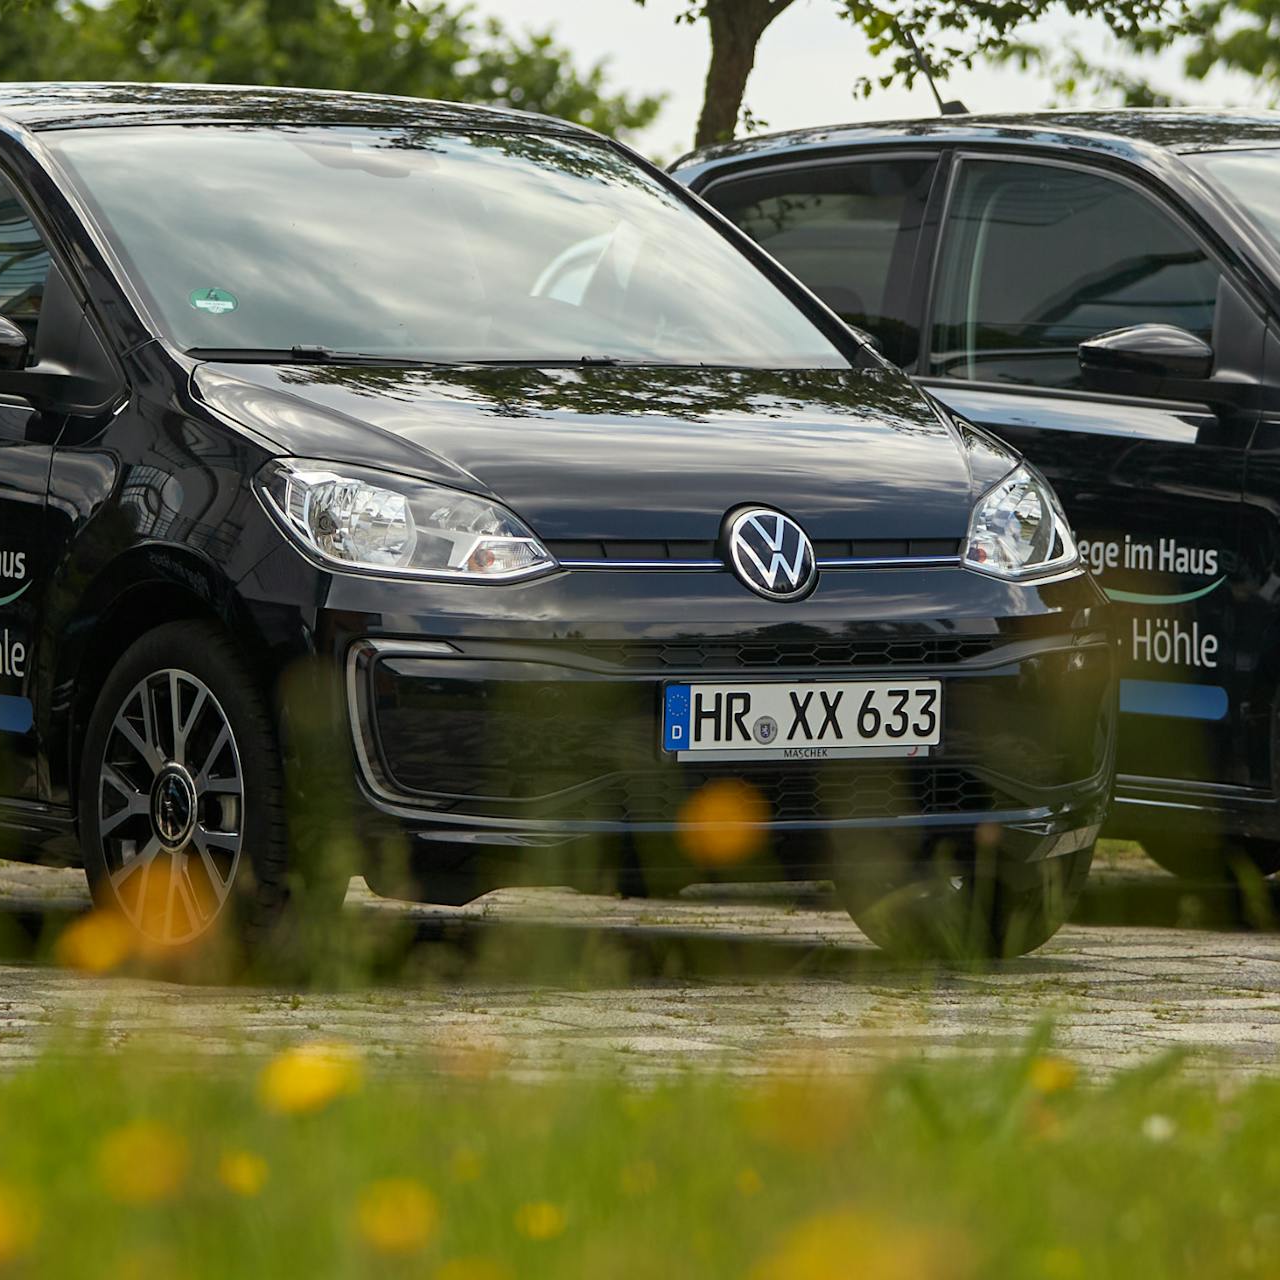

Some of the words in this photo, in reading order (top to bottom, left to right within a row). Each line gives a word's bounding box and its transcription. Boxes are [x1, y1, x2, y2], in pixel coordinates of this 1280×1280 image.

[732, 512, 809, 588] VW
[1124, 534, 1152, 571] im
[1159, 538, 1218, 576] Haus
[1133, 617, 1218, 668] Höhle
[672, 725, 682, 739] D
[694, 692, 752, 742] HR
[787, 691, 844, 741] XX
[857, 689, 937, 738] 633
[783, 747, 828, 758] MASCHEK
